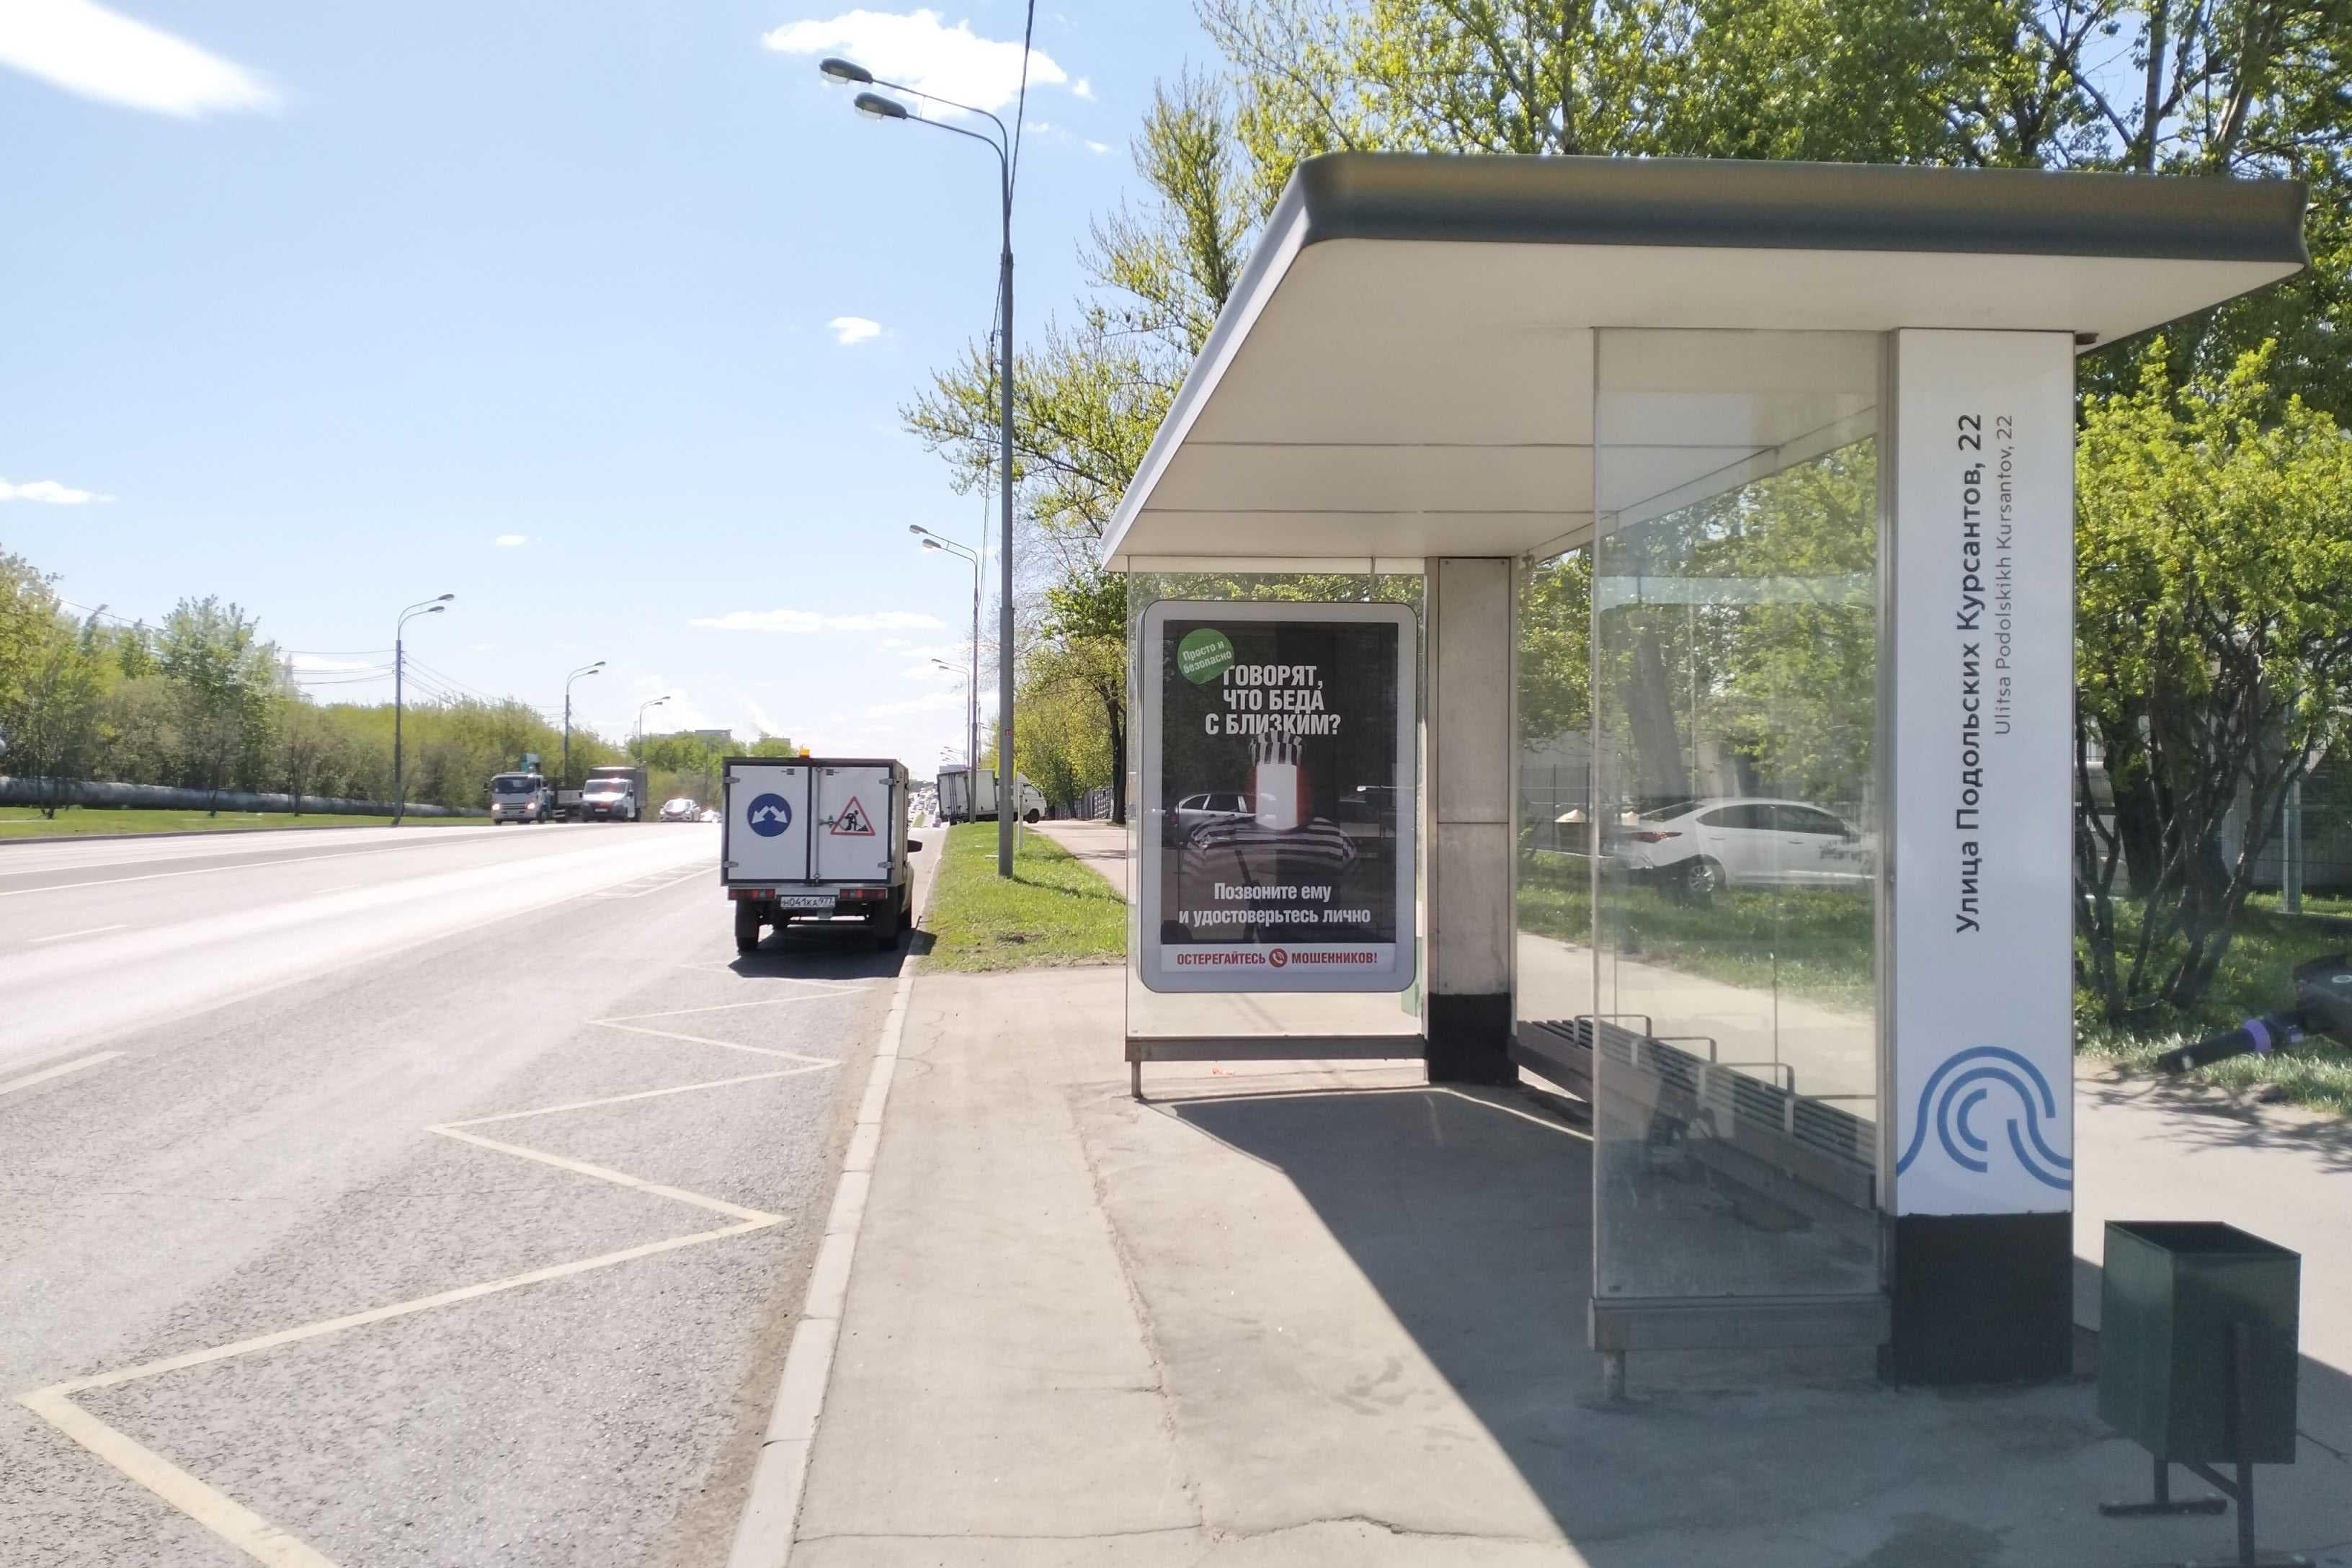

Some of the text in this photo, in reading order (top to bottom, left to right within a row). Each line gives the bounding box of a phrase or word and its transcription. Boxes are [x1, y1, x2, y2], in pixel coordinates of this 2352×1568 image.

[1995, 415, 2015, 735] Ulitsa Podolskikh Kursantov, 22
[1182, 641, 1224, 662] Просто и
[1182, 651, 1232, 674] безопасно
[1224, 664, 1323, 689] ГОВОРЯТ,
[1956, 414, 1987, 933] Улица Подольских Курсантов, 22
[1224, 689, 1324, 713] ЧТО БЕДА
[1206, 713, 1342, 735] С БЛИЗКИМ?
[1214, 882, 1331, 902] Позвоните ему
[1179, 909, 1371, 927] и удостоверьтесь лично
[1177, 950, 1378, 966] ОСТЕРЕГАЙТЕСЬ МОШЕННИКОВ!
